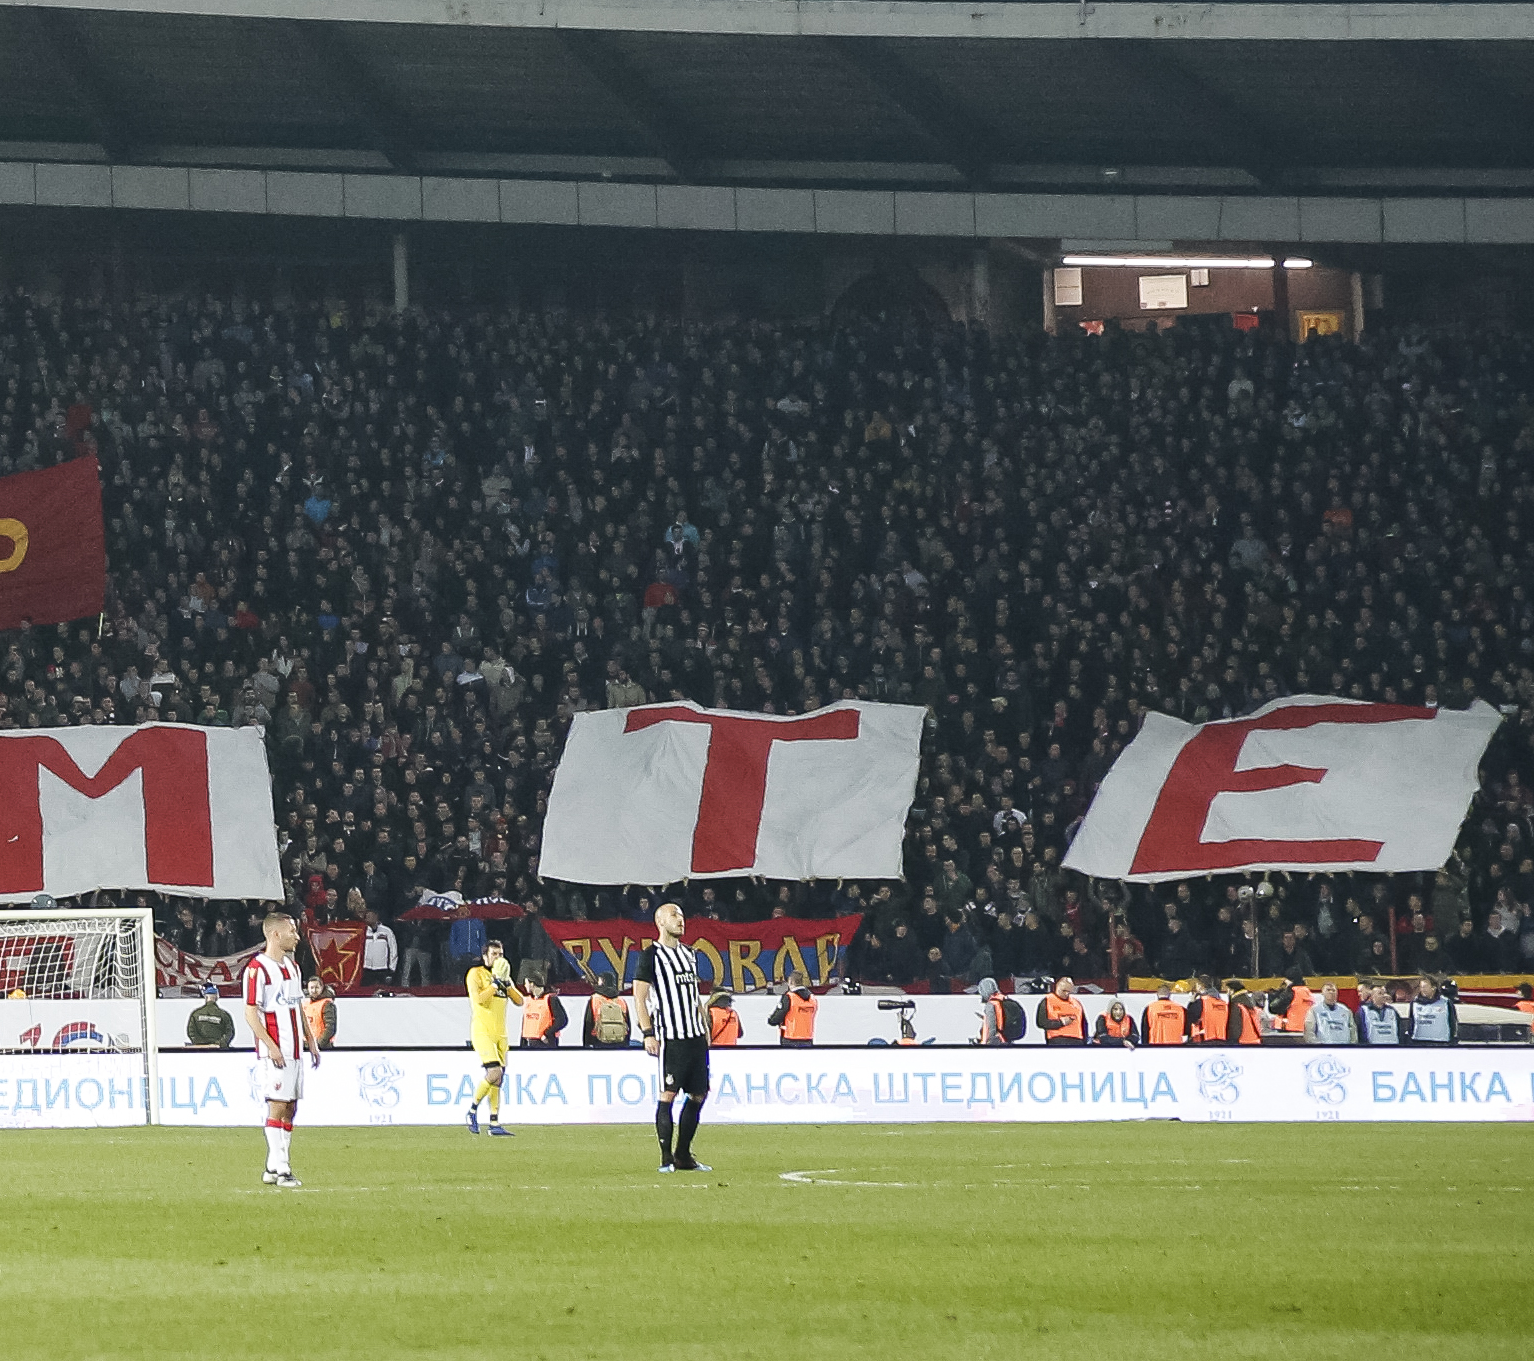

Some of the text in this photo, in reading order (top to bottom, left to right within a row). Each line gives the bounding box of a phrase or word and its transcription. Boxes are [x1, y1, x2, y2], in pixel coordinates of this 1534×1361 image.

[561, 934, 840, 993] ВУОВАР
[675, 972, 695, 984] mts
[587, 1072, 858, 1106] ПОАНСКА
[873, 1070, 1179, 1109] ШТЕДИОНИЦА
[1371, 1070, 1512, 1103] БАНКА
